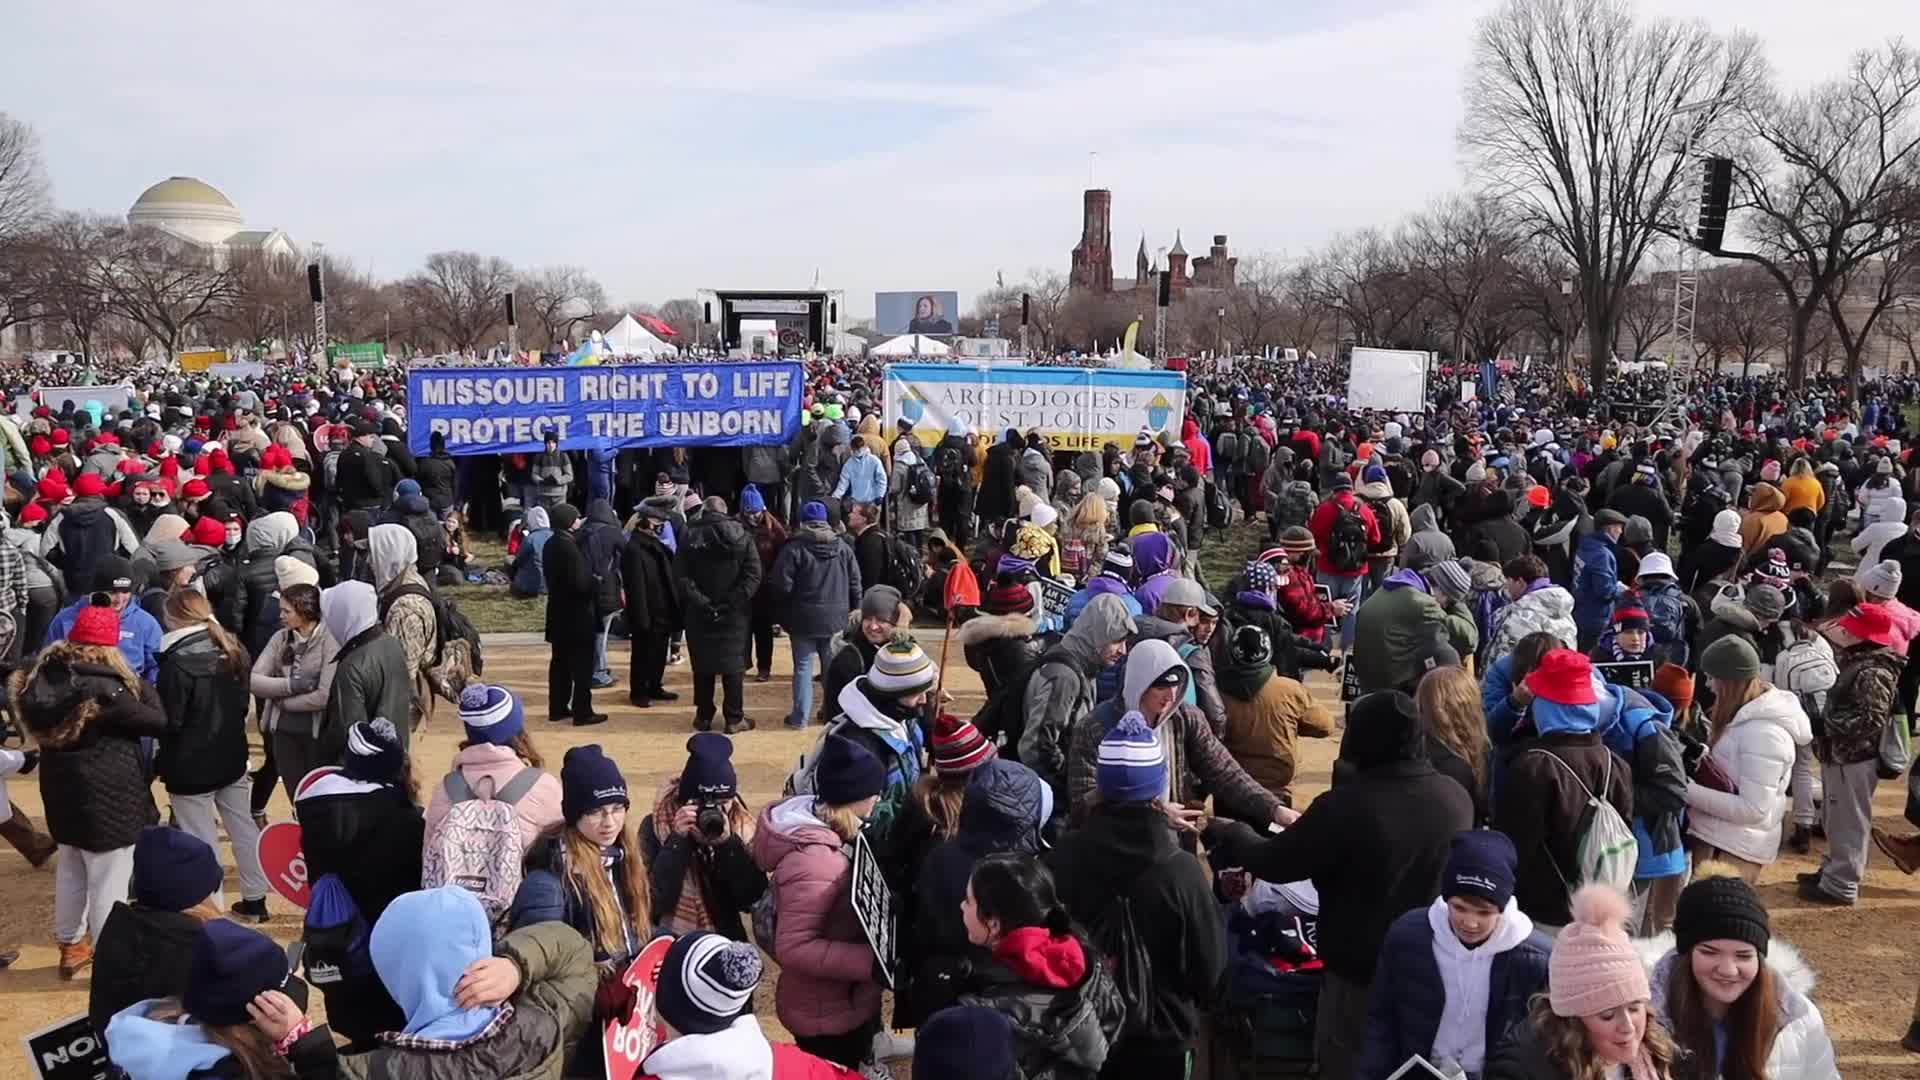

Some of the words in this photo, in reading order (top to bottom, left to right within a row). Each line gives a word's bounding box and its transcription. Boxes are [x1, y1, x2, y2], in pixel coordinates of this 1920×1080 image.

[422, 377, 565, 405] MISSOURI
[579, 373, 667, 400] RIGHT
[682, 373, 719, 398] TO
[733, 371, 791, 398] LIFE
[943, 385, 1137, 409] ARCHDIOCESE
[430, 416, 571, 443] PROTECT
[587, 412, 645, 437] THE
[660, 410, 782, 436] UNBORN
[953, 409, 986, 427] OF
[999, 410, 1030, 430] ST.
[1039, 411, 1117, 432] LOUIS
[1066, 437, 1100, 447] LIFE
[1045, 589, 1059, 600] AM
